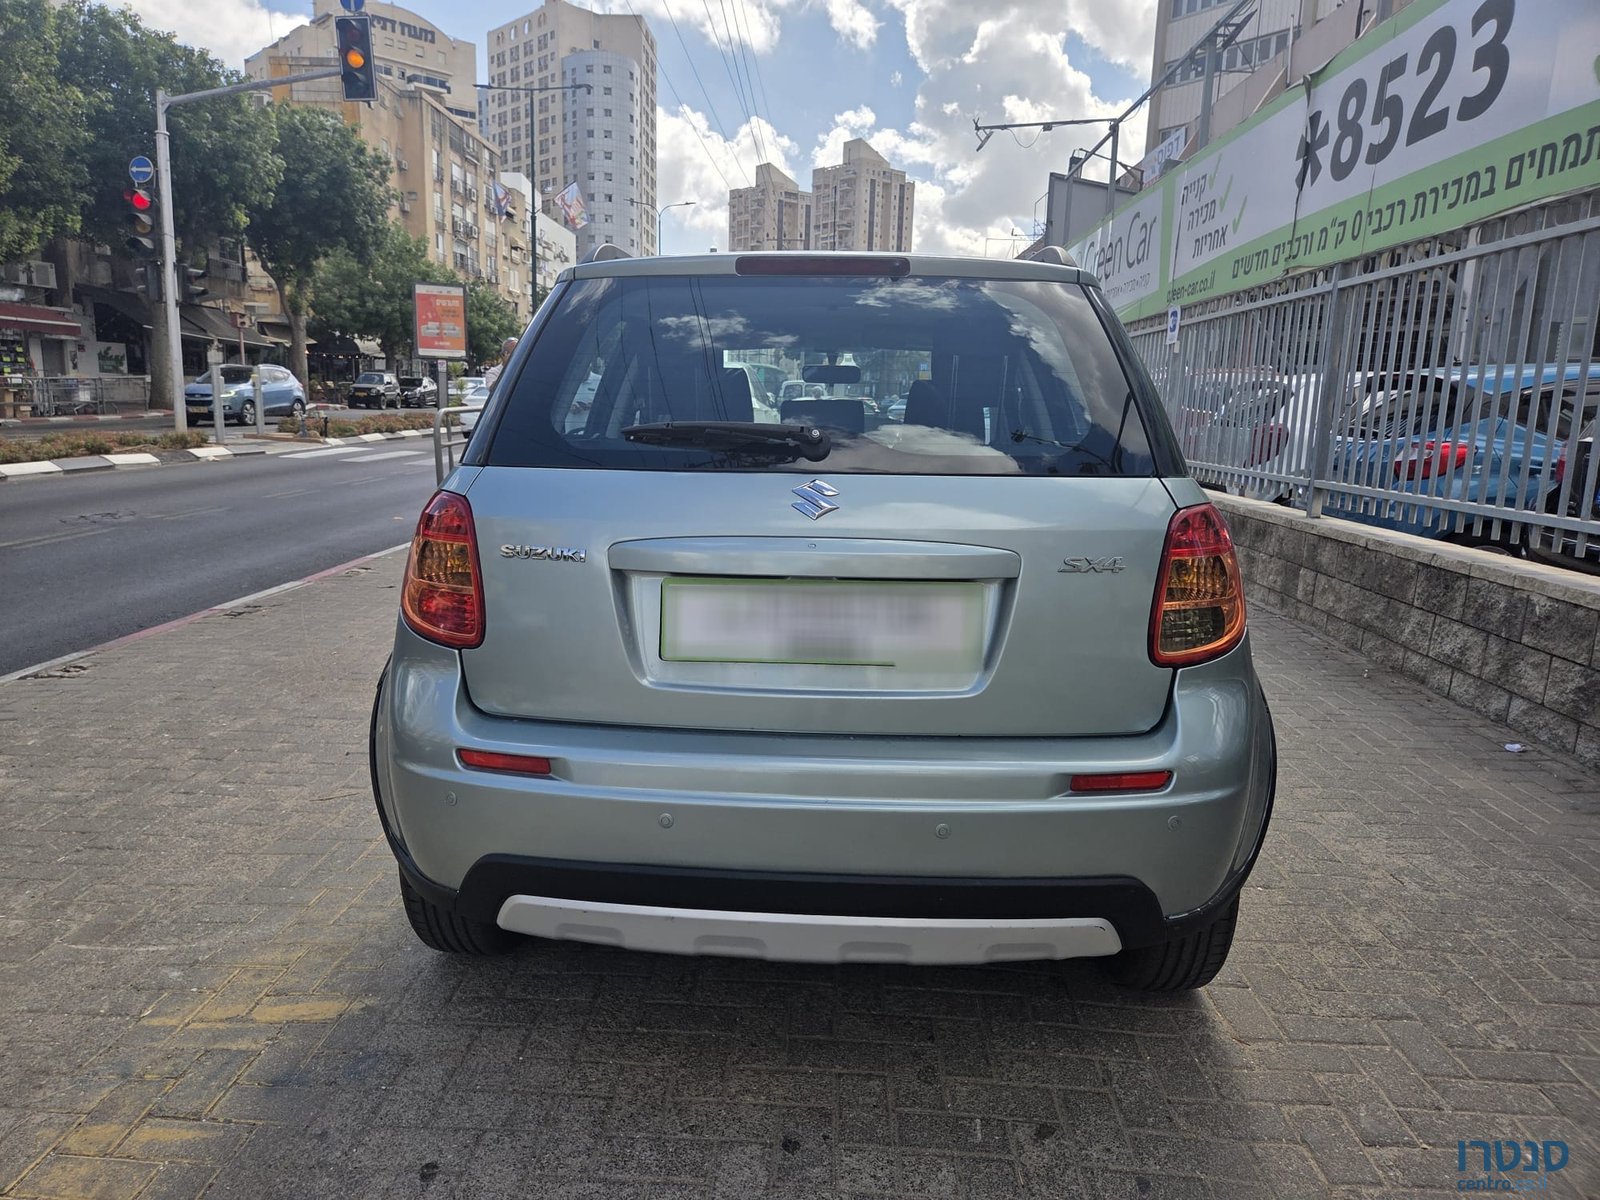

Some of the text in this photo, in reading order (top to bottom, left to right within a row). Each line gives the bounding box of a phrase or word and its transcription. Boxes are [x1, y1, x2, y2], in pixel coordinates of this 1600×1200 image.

[1181, 173, 1208, 206] קנייה
[1409, 165, 1497, 222] במכירת
[1187, 199, 1217, 232] מכירה
[1367, 198, 1407, 236] רכבי
[1126, 211, 1157, 269] Car
[1192, 223, 1229, 259] אחריות
[1231, 248, 1269, 280] חדשים
[500, 543, 587, 563] SUZUKI
[1057, 556, 1127, 574] SX4
